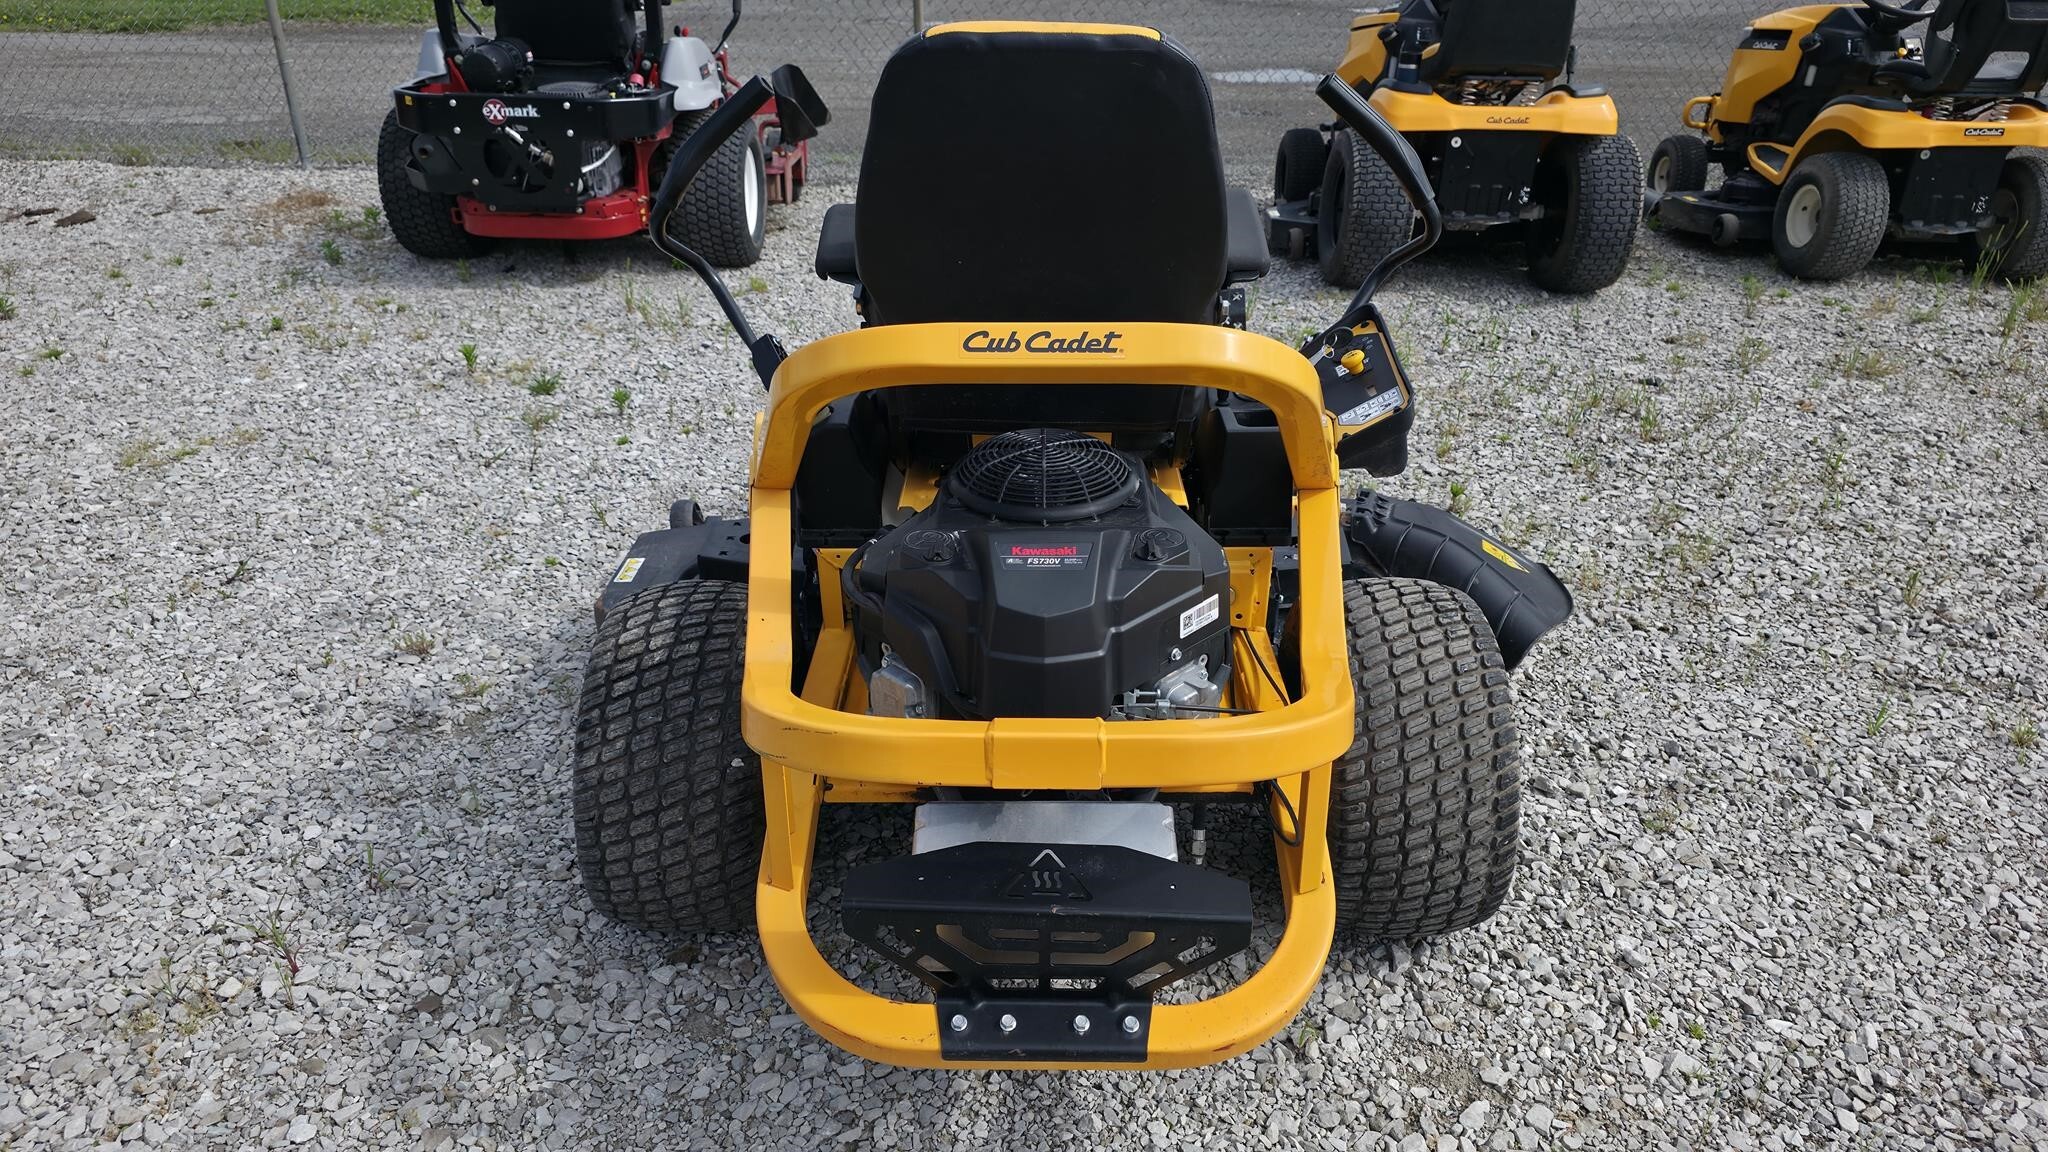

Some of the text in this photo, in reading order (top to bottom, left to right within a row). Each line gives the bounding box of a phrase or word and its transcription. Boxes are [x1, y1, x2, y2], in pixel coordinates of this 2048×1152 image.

[962, 330, 1123, 354] Cub Cadet
[1011, 545, 1077, 556] Kawasaki
[1027, 557, 1061, 565] FS730V
